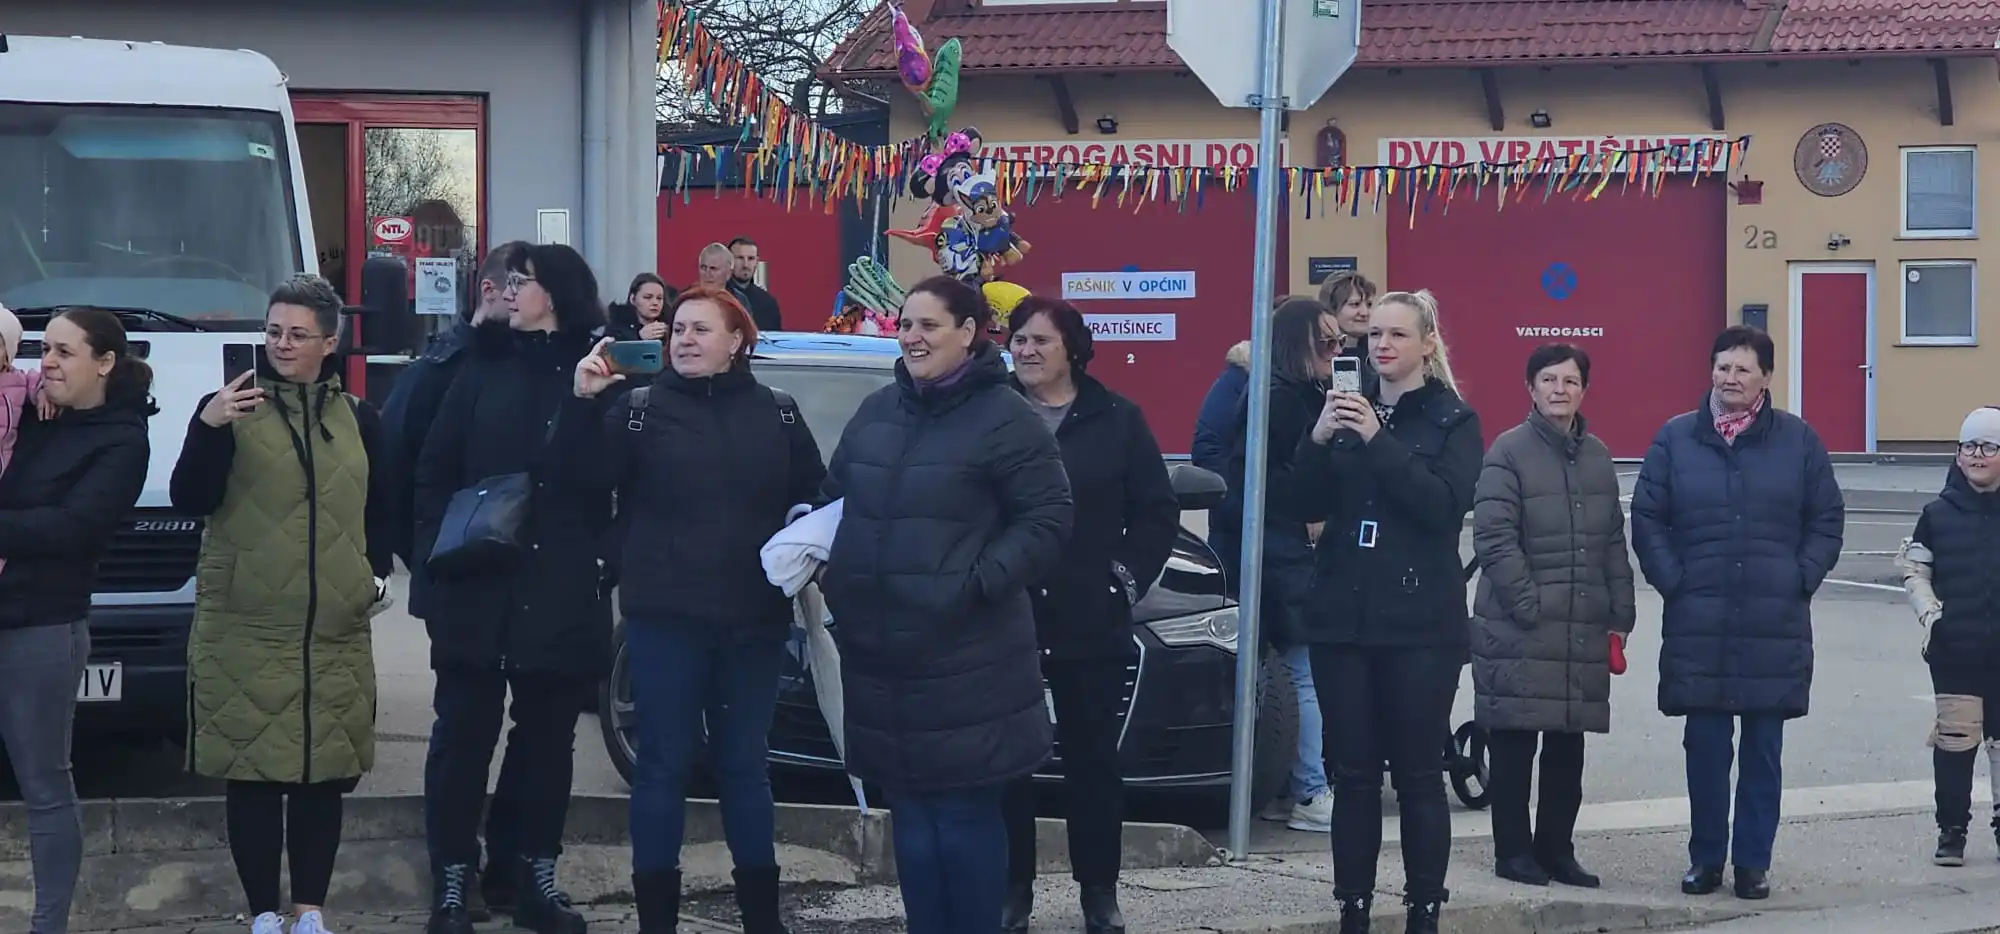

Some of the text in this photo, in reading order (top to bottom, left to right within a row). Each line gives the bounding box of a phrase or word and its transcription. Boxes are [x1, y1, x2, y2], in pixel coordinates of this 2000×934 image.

[1205, 142, 1284, 169] DO
[1388, 140, 1466, 169] DVD
[1743, 225, 1777, 249] 2a
[1067, 276, 1187, 293] FAŠNIK V OPĆINI
[1516, 327, 1604, 337] VATROGASCI
[1126, 353, 1135, 364] 2
[134, 521, 196, 531] 208D
